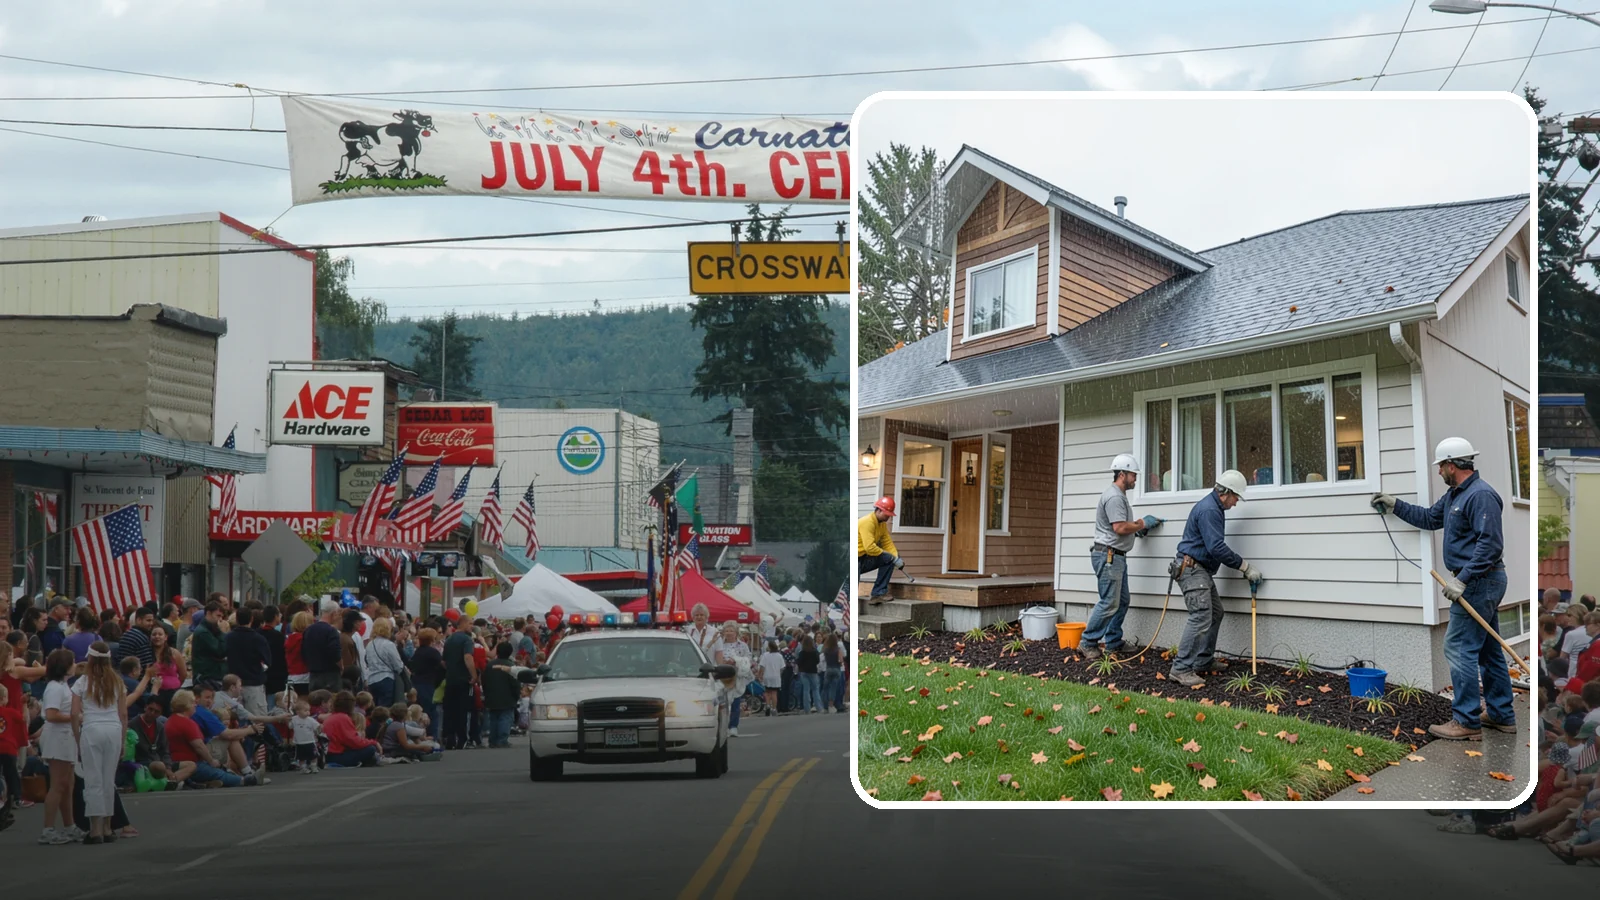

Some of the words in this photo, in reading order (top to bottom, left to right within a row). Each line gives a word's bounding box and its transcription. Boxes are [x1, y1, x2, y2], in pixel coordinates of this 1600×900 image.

[481, 140, 605, 193] JULY
[632, 149, 746, 198] 4th.
[282, 380, 373, 420] ACE
[405, 409, 453, 422] CEDAR
[283, 421, 371, 436] Hardware
[417, 428, 476, 446] Coca-Cola
[96, 486, 124, 495] Vincent
[126, 486, 136, 495] de
[138, 487, 155, 495] Paul
[699, 535, 730, 543] GLASS
